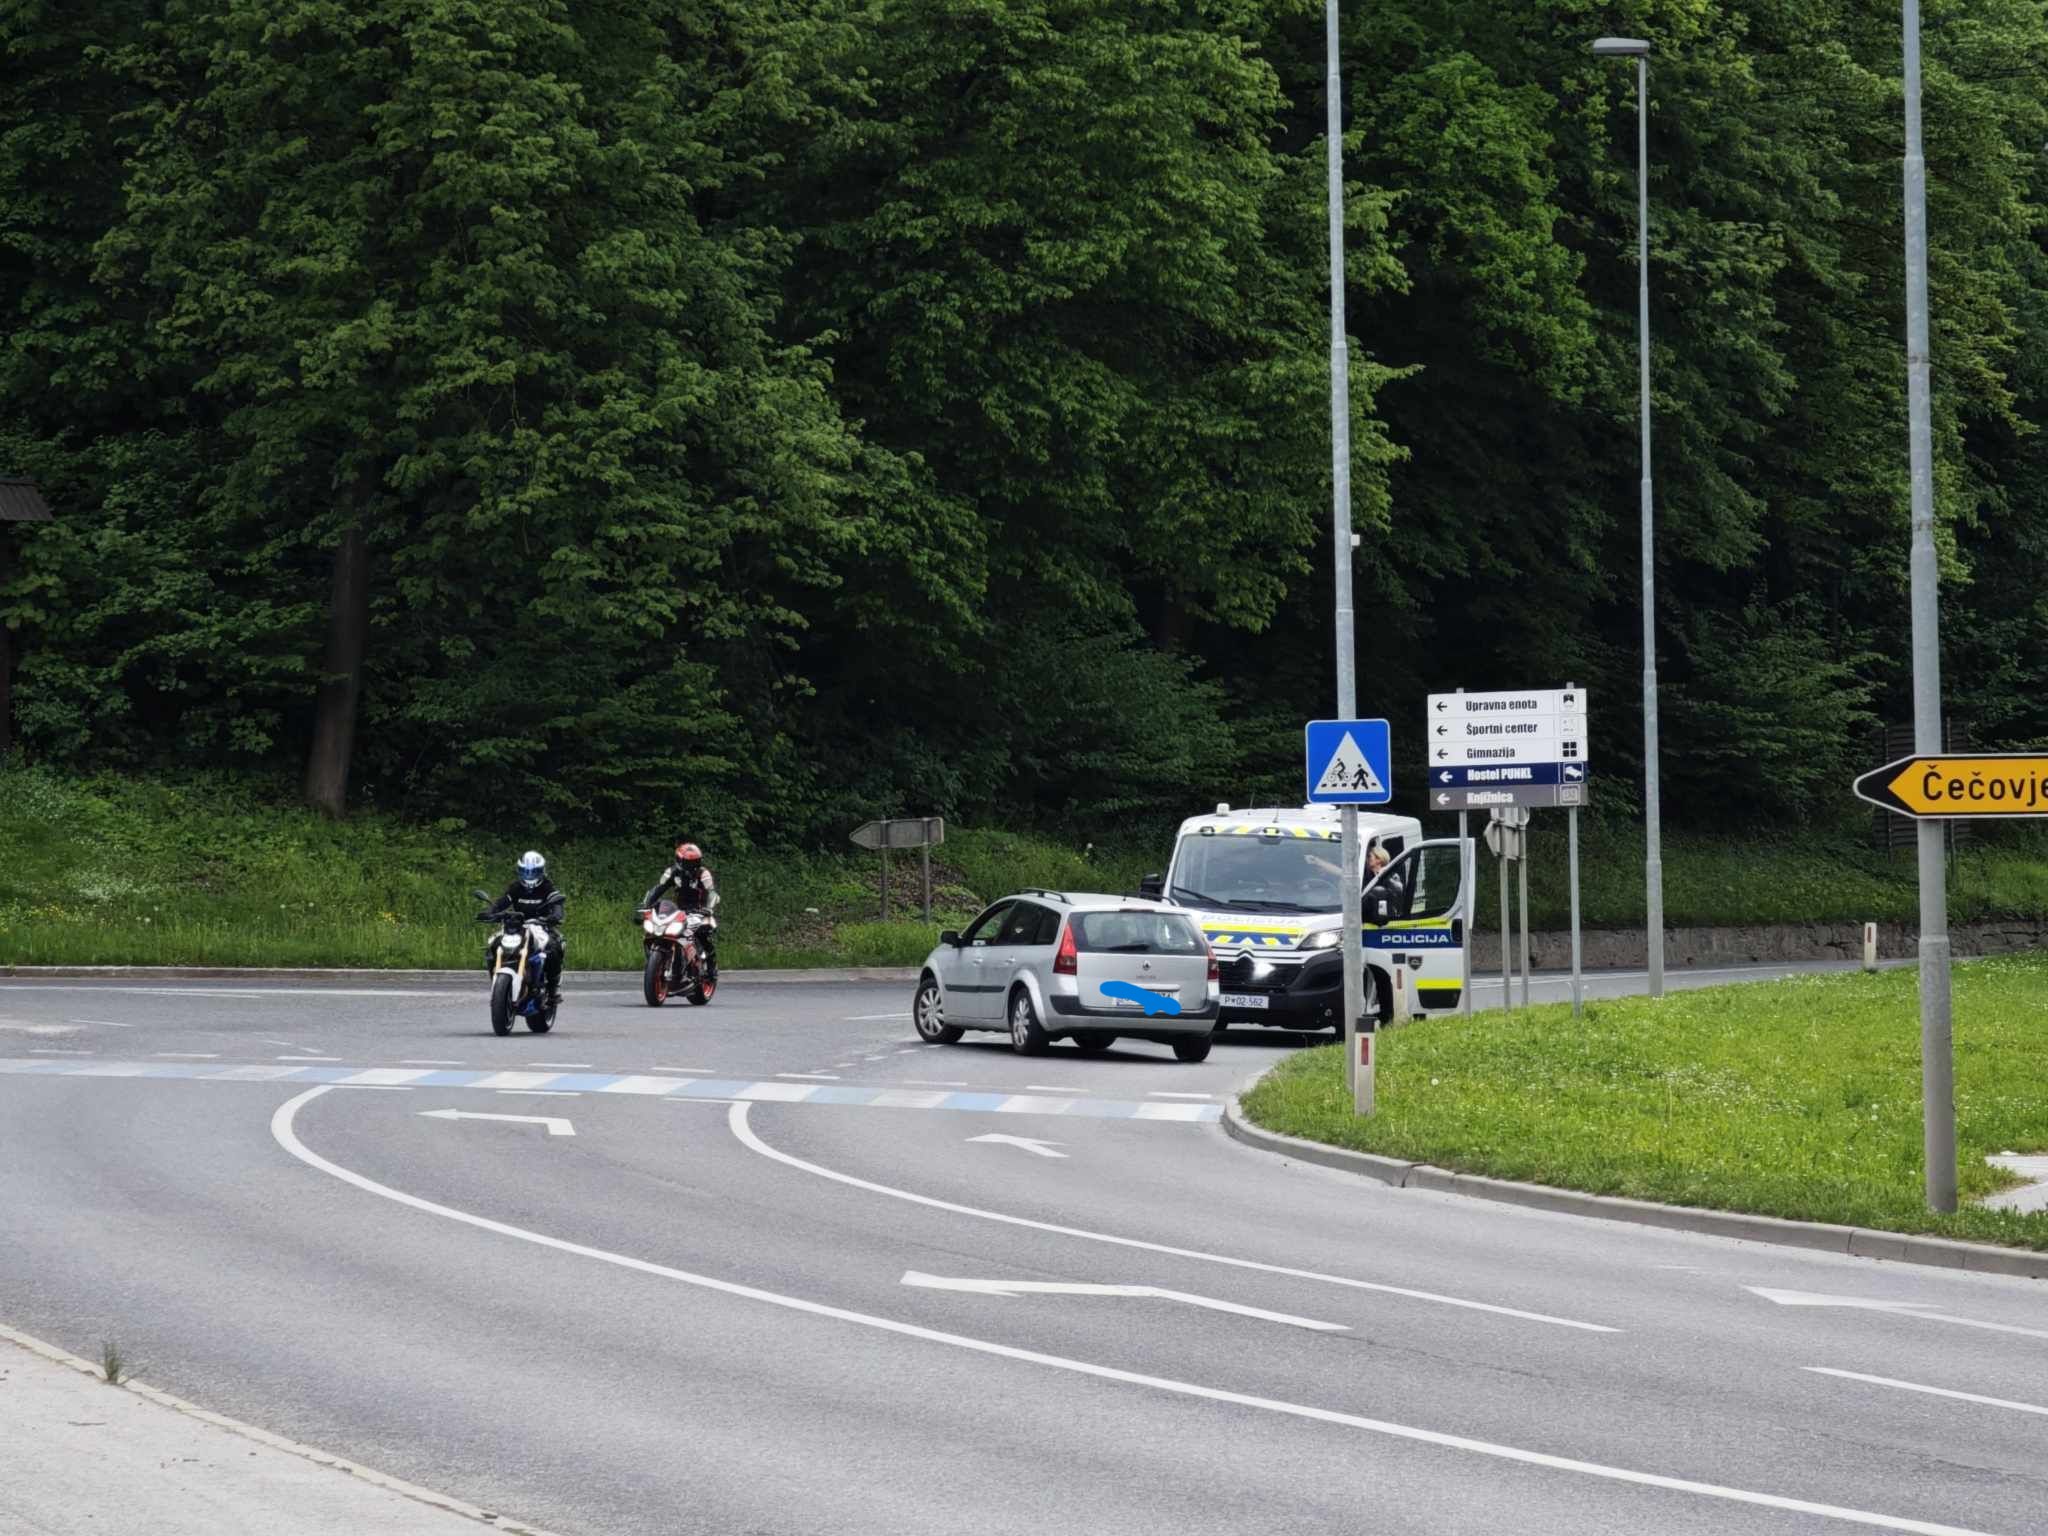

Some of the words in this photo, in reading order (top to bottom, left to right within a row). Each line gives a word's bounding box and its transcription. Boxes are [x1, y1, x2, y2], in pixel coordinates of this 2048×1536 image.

[1466, 700, 1506, 712] Upravna
[1509, 699, 1537, 710] enota
[1466, 722, 1503, 736] Športni
[1505, 723, 1538, 733] center
[1467, 747, 1515, 759] Gimnazija
[1467, 769, 1499, 781] Hostel
[1467, 791, 1513, 804] Knjižnica
[1381, 934, 1449, 944] POLICIJA
